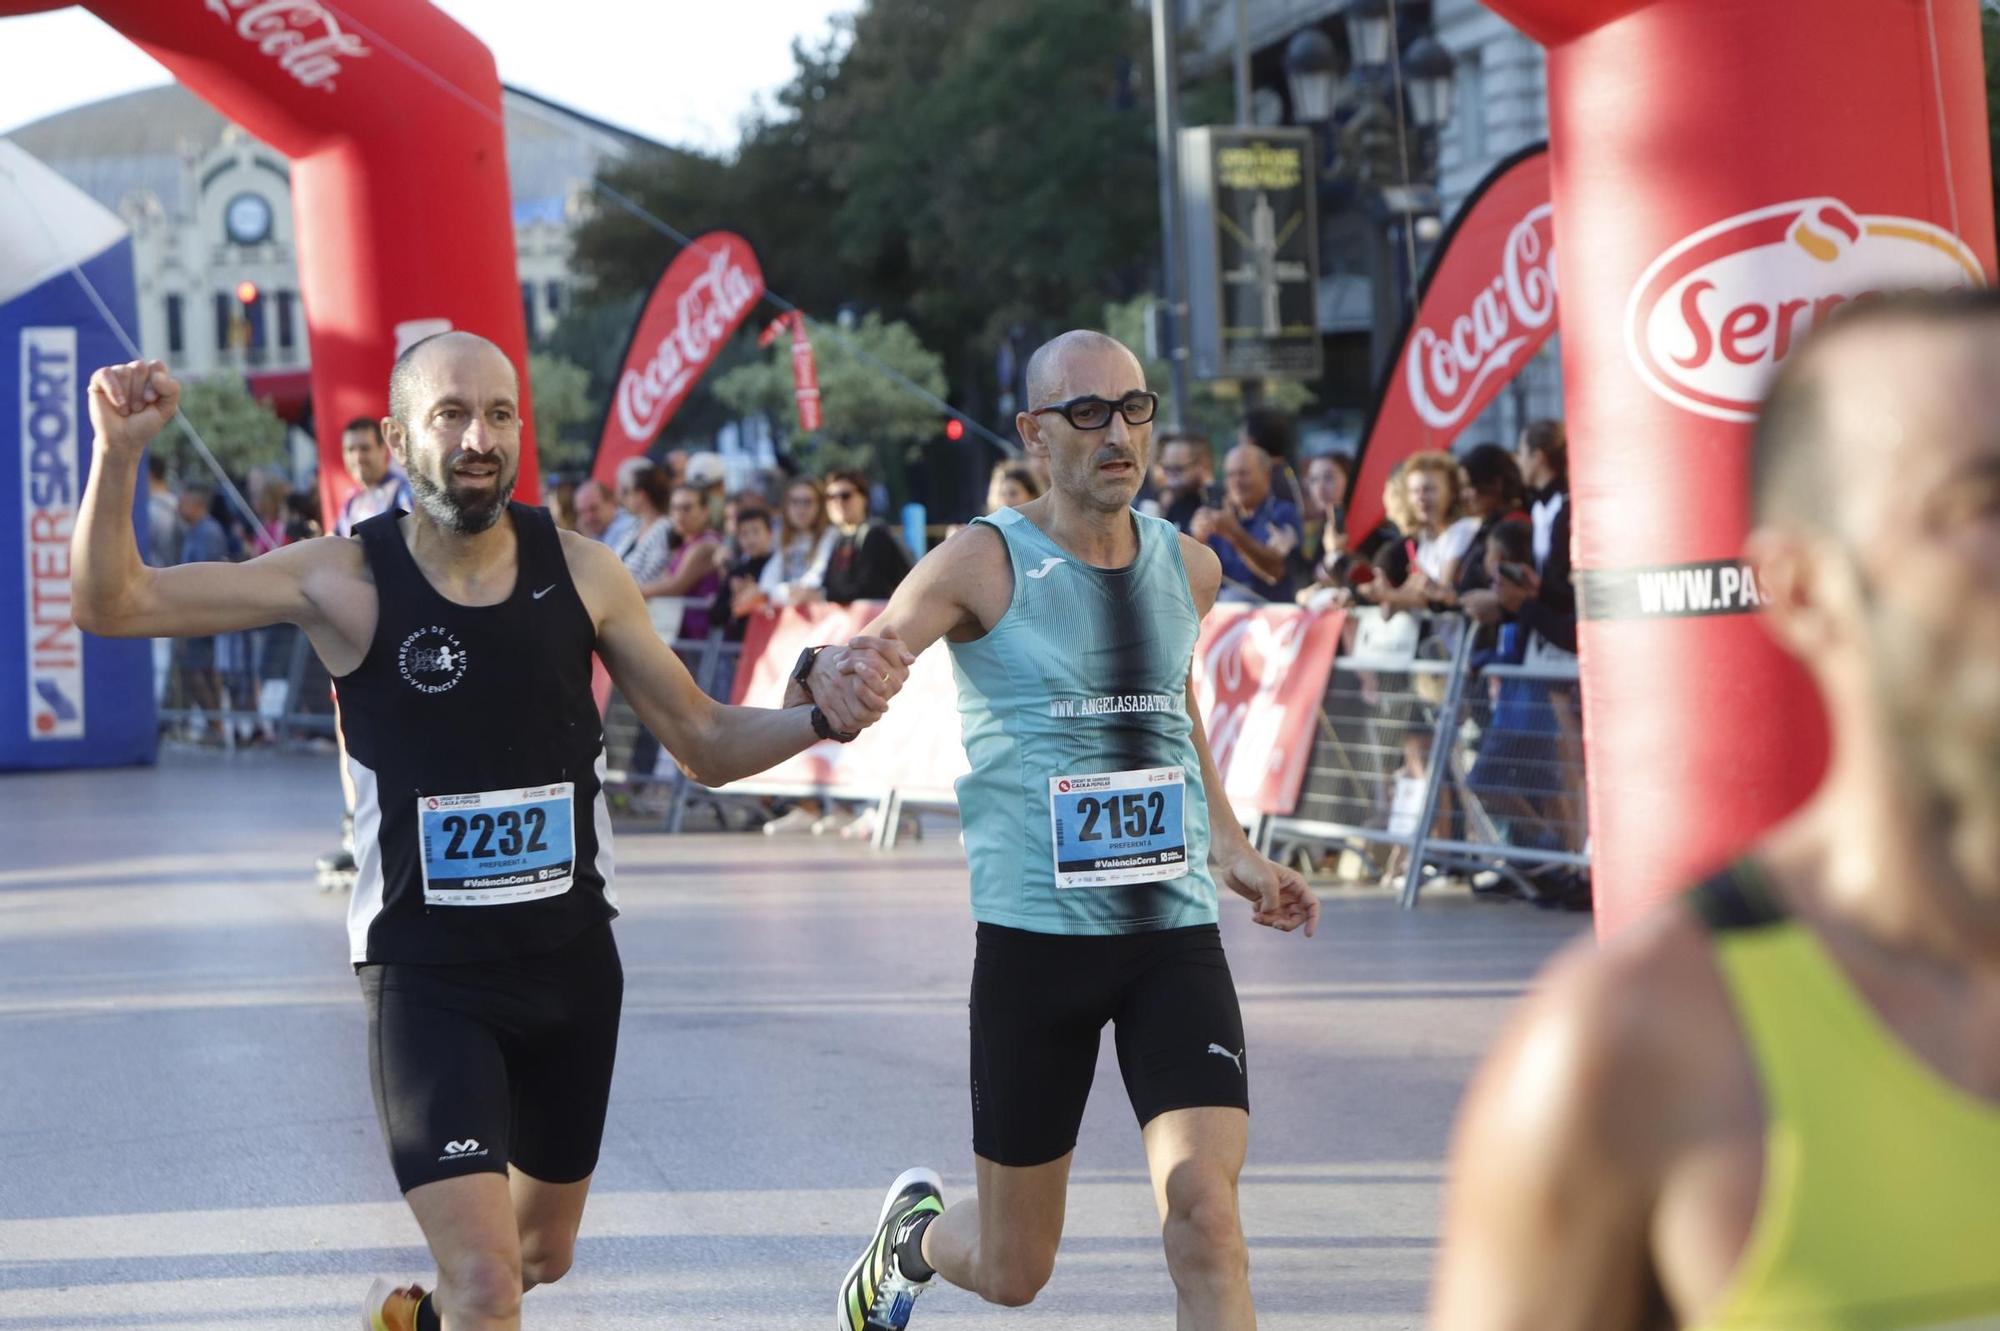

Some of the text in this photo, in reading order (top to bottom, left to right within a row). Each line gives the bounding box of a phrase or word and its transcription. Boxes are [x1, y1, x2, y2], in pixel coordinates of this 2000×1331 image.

[618, 243, 763, 441] Coca-Cola
[29, 345, 77, 669] INTERSPORT
[1637, 566, 1770, 613] WWW.PA
[431, 625, 446, 635] DE
[448, 634, 460, 647] LA
[455, 650, 467, 677] RUTA
[442, 807, 548, 860] 2232
[1077, 791, 1165, 842] 2152
[479, 860, 521, 869] PREFERENT
[1095, 856, 1156, 868] #ValènciaCorre
[1109, 841, 1146, 849] PREFERENT
[463, 874, 535, 887] #ValènciaCorre
